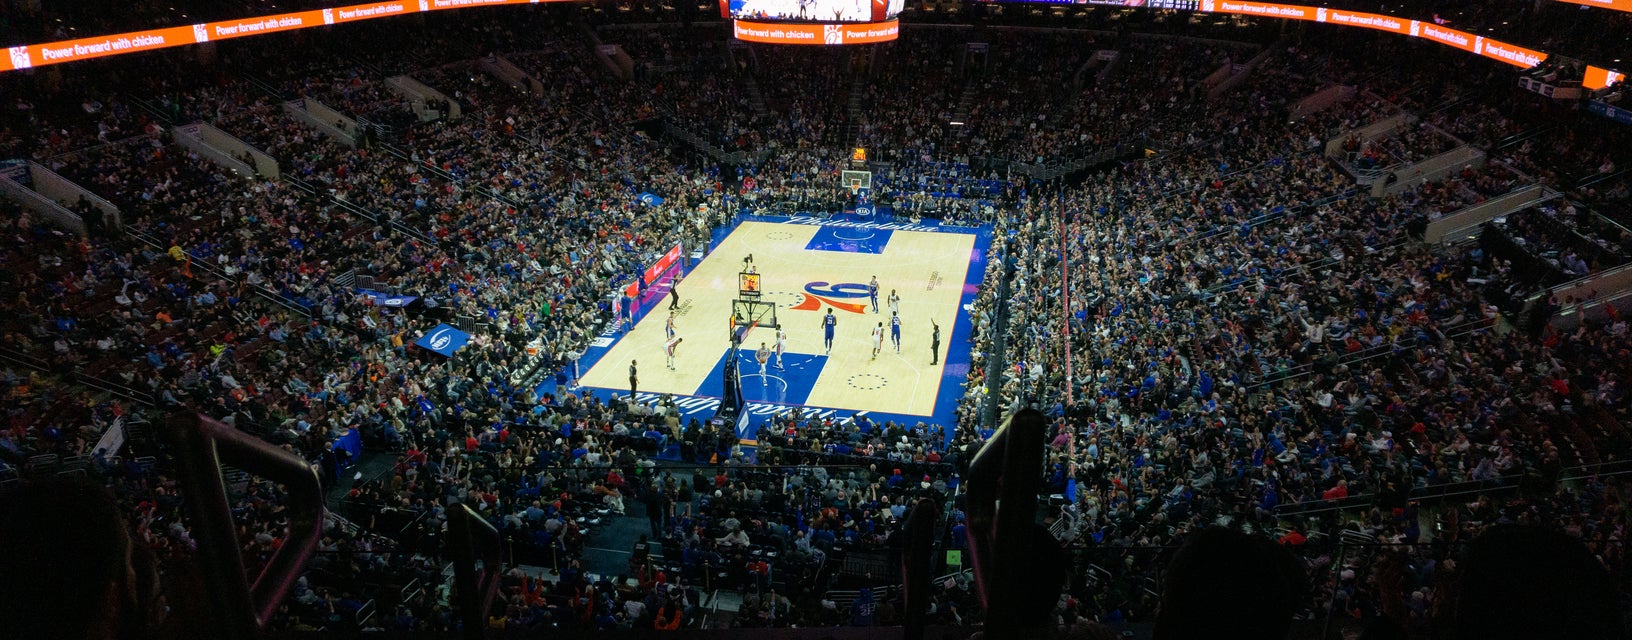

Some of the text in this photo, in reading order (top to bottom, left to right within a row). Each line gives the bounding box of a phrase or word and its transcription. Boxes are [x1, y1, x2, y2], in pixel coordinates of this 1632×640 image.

[339, 4, 403, 19] Power forward with chicken
[1222, 3, 1304, 17] Power forward with chicken
[216, 16, 302, 35] Power forward with chicken
[1332, 12, 1401, 30] Power forward with chicken
[749, 27, 769, 37] forward
[770, 30, 784, 38] with
[786, 30, 814, 39] chicken
[846, 30, 867, 39] Power
[868, 28, 887, 37] forward
[42, 34, 164, 60] Power forward with chicken
[1486, 43, 1498, 55] Power
[1498, 46, 1515, 60] forward
[783, 213, 938, 232] Philadelphia
